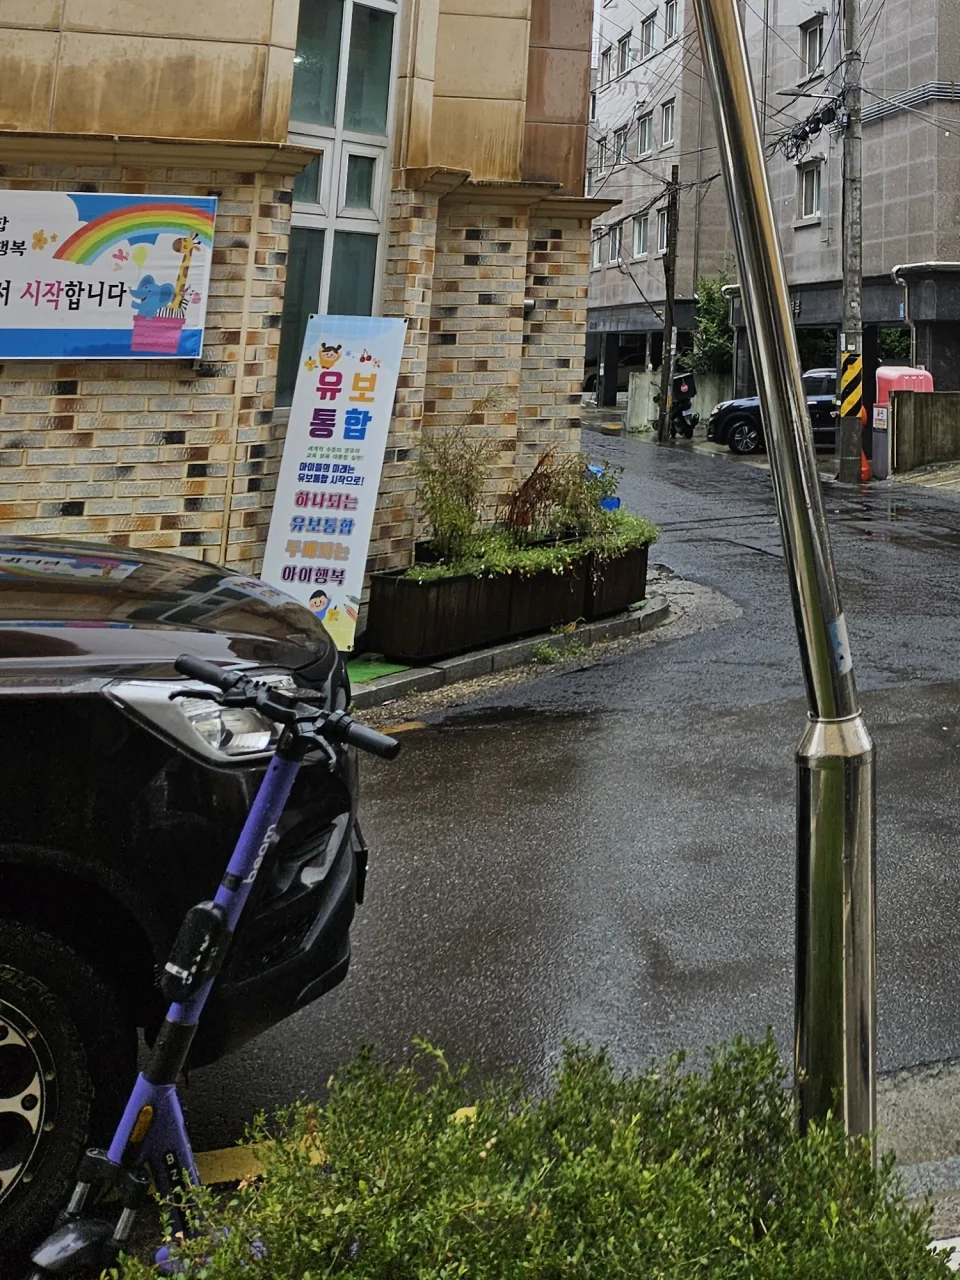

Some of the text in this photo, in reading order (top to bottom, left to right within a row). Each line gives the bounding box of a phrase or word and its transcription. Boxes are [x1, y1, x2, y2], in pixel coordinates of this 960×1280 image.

[20, 280, 127, 310] 시작합니다
[299, 462, 355, 474] 아이들의 미래는
[297, 473, 365, 486] 유보통합 시작으로!
[295, 489, 359, 511] 하나되는
[290, 515, 355, 536] 유보통합
[281, 564, 346, 587] 아이행복
